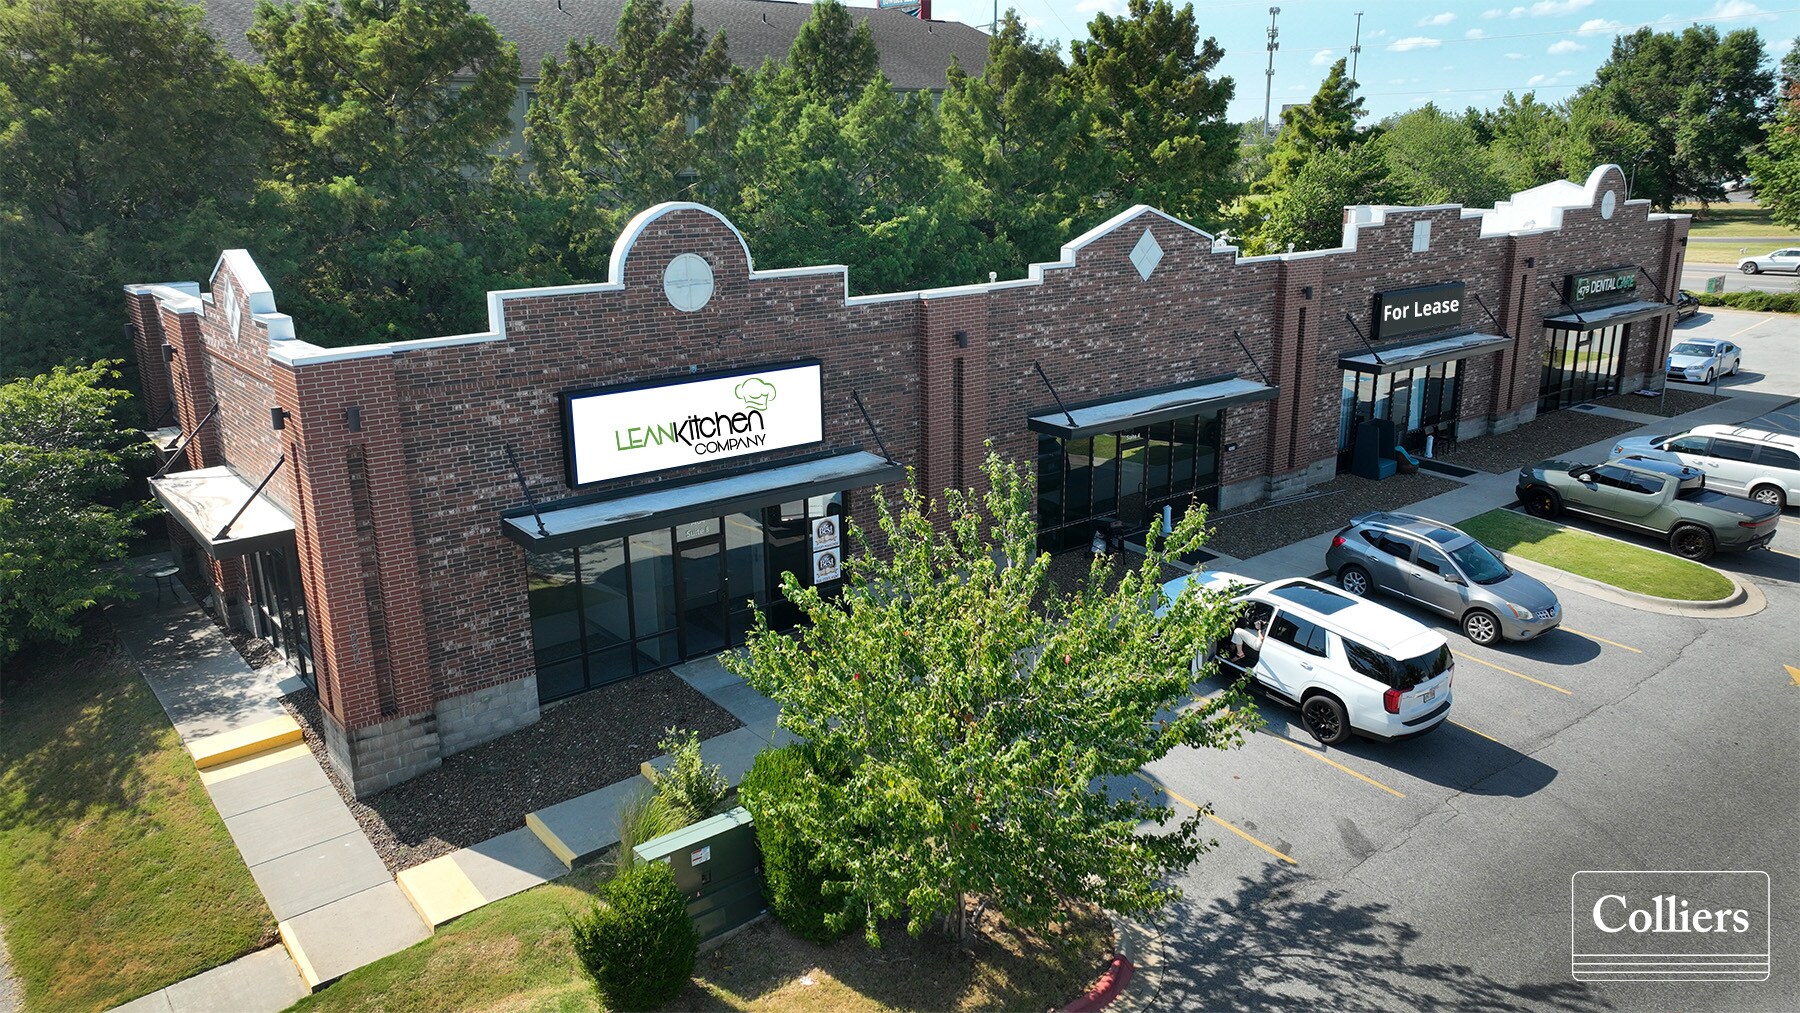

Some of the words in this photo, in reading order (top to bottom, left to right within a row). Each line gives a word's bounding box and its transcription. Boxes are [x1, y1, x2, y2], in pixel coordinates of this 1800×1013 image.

[1384, 304, 1408, 321] For
[1414, 298, 1459, 317] Lease
[695, 434, 766, 455] COMPANY
[686, 528, 704, 538] Suite
